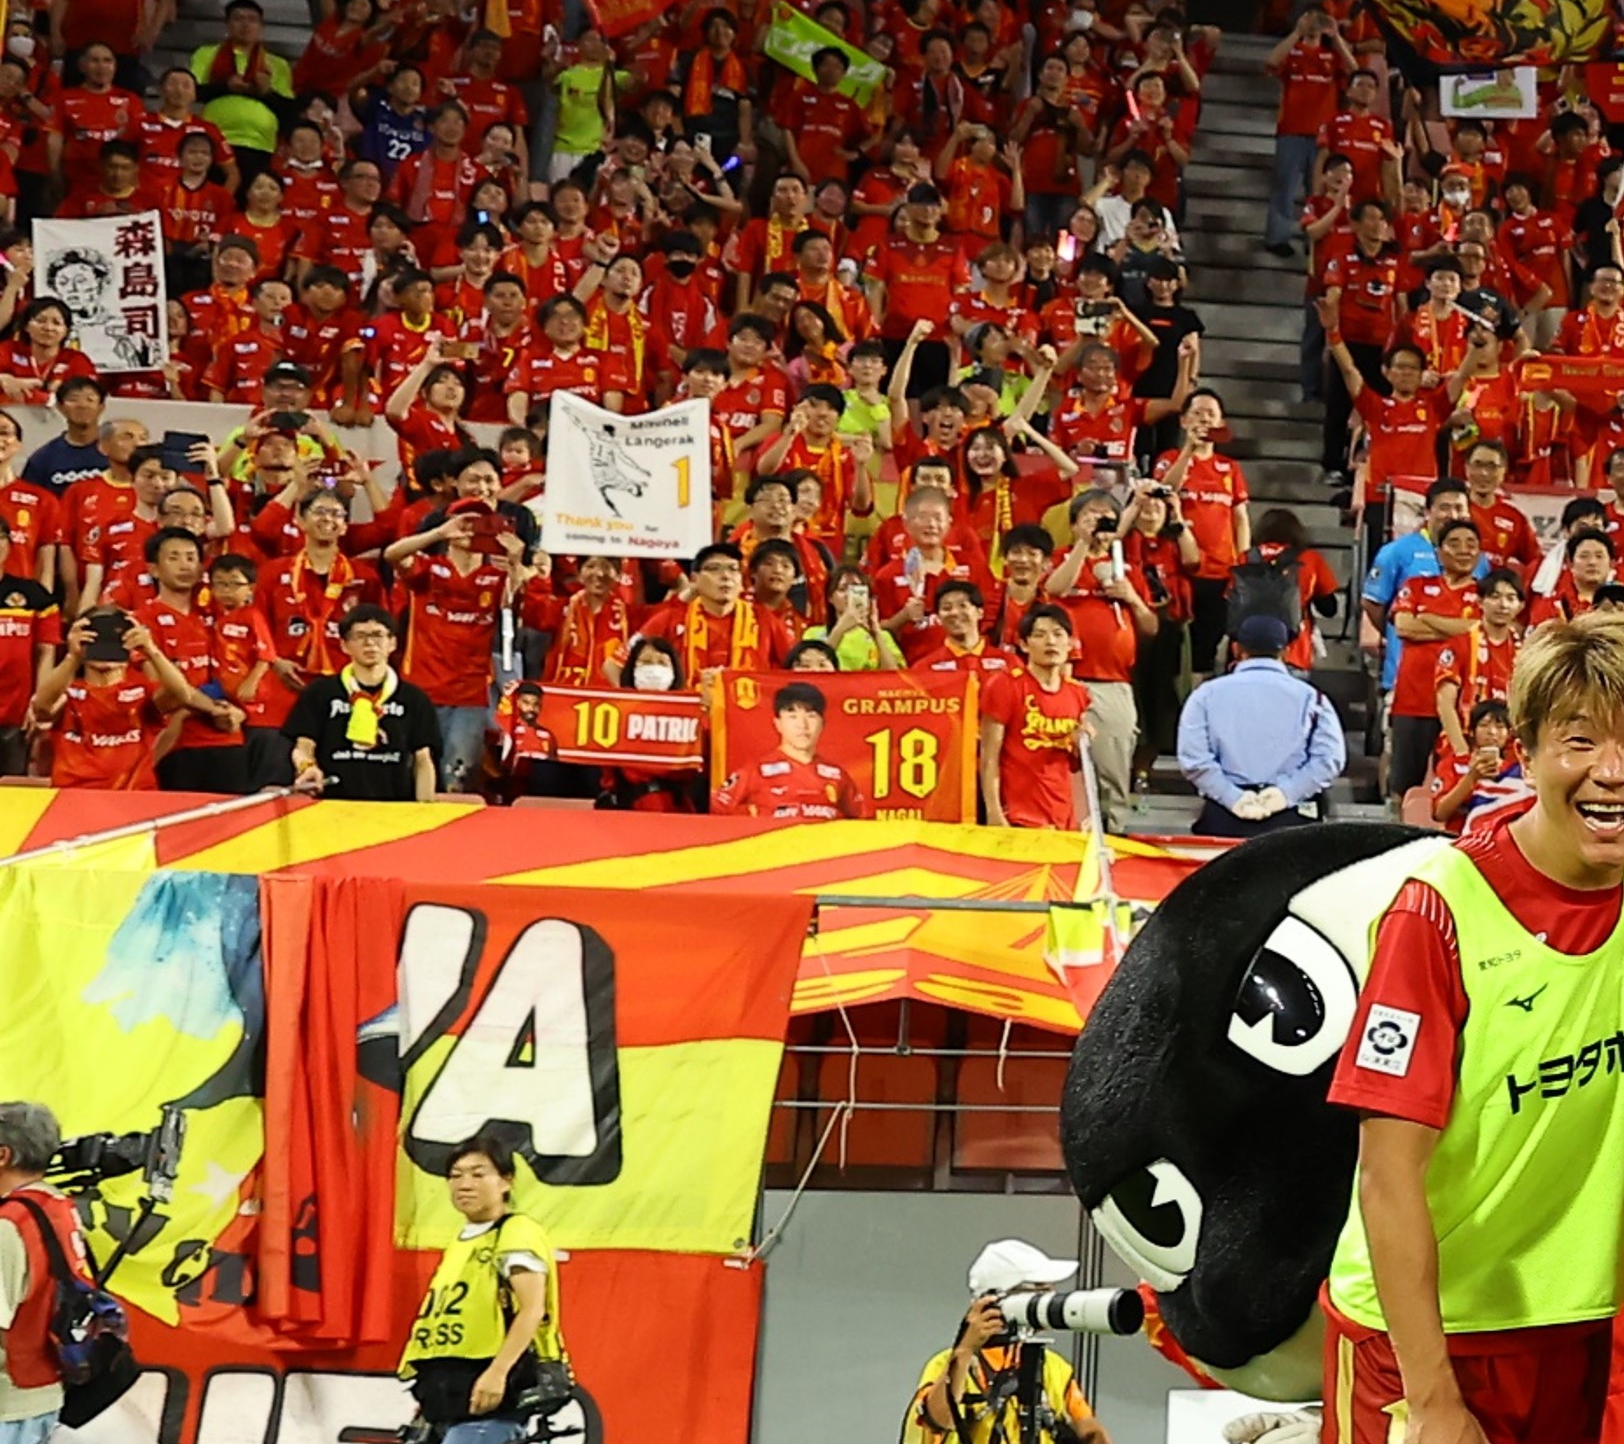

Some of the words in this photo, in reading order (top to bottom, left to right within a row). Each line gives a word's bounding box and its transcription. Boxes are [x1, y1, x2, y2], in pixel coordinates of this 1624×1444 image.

[113, 219, 160, 340] 森島司
[625, 434, 696, 451] Langerak
[669, 456, 692, 508] 1
[554, 512, 598, 528] Thank
[574, 701, 618, 747] 10
[842, 697, 961, 715] GRAMPUS
[865, 727, 939, 799] 18
